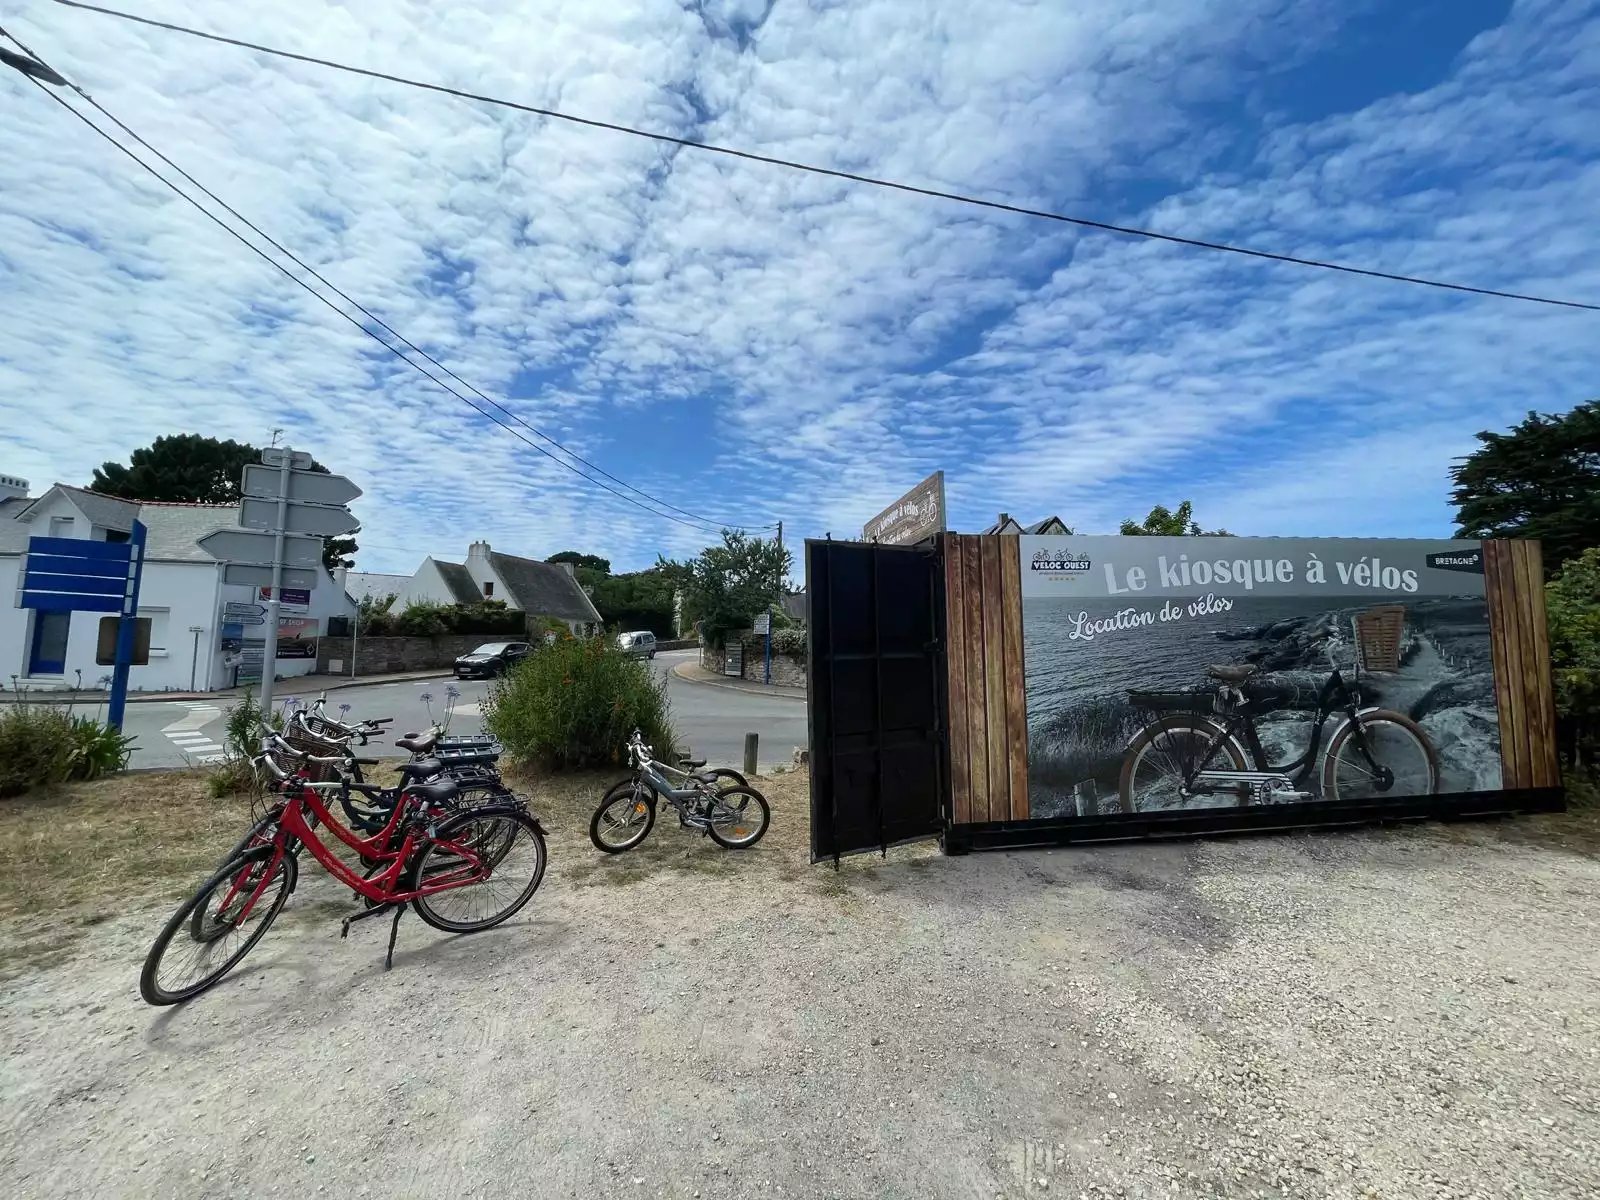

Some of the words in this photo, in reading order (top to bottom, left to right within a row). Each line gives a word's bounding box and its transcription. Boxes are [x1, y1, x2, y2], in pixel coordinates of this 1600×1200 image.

[1103, 562, 1147, 595] Le
[1158, 554, 1294, 589] kiosque
[1305, 552, 1327, 584] à
[1335, 556, 1419, 593] vélos
[1435, 557, 1474, 565] BRETAGNE
[1068, 607, 1155, 641] Location
[1159, 600, 1183, 623] de
[1187, 592, 1234, 618] vélos
